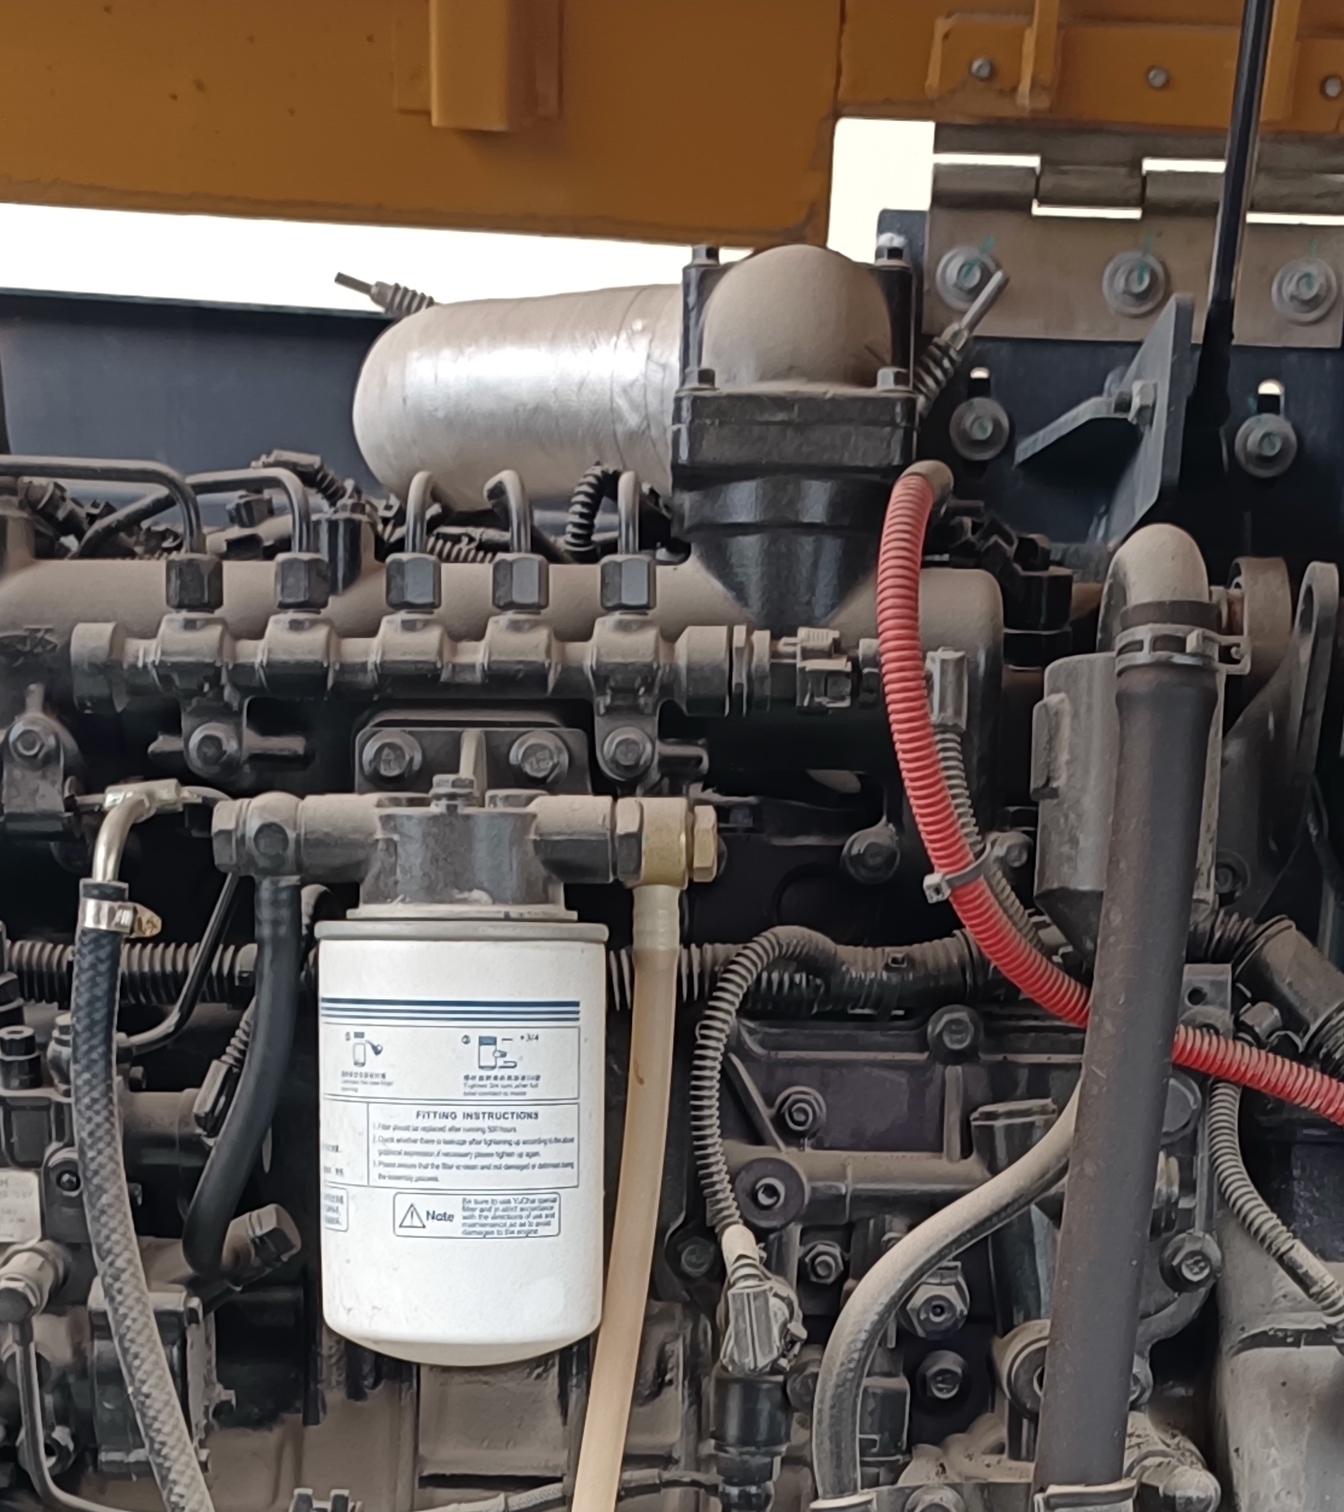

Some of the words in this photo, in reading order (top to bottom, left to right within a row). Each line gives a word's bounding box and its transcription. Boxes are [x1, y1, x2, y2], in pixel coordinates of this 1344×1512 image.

[416, 1110, 457, 1120] FITTING
[463, 1111, 539, 1121] INSTRUCTIONS
[426, 1209, 455, 1223] Note
